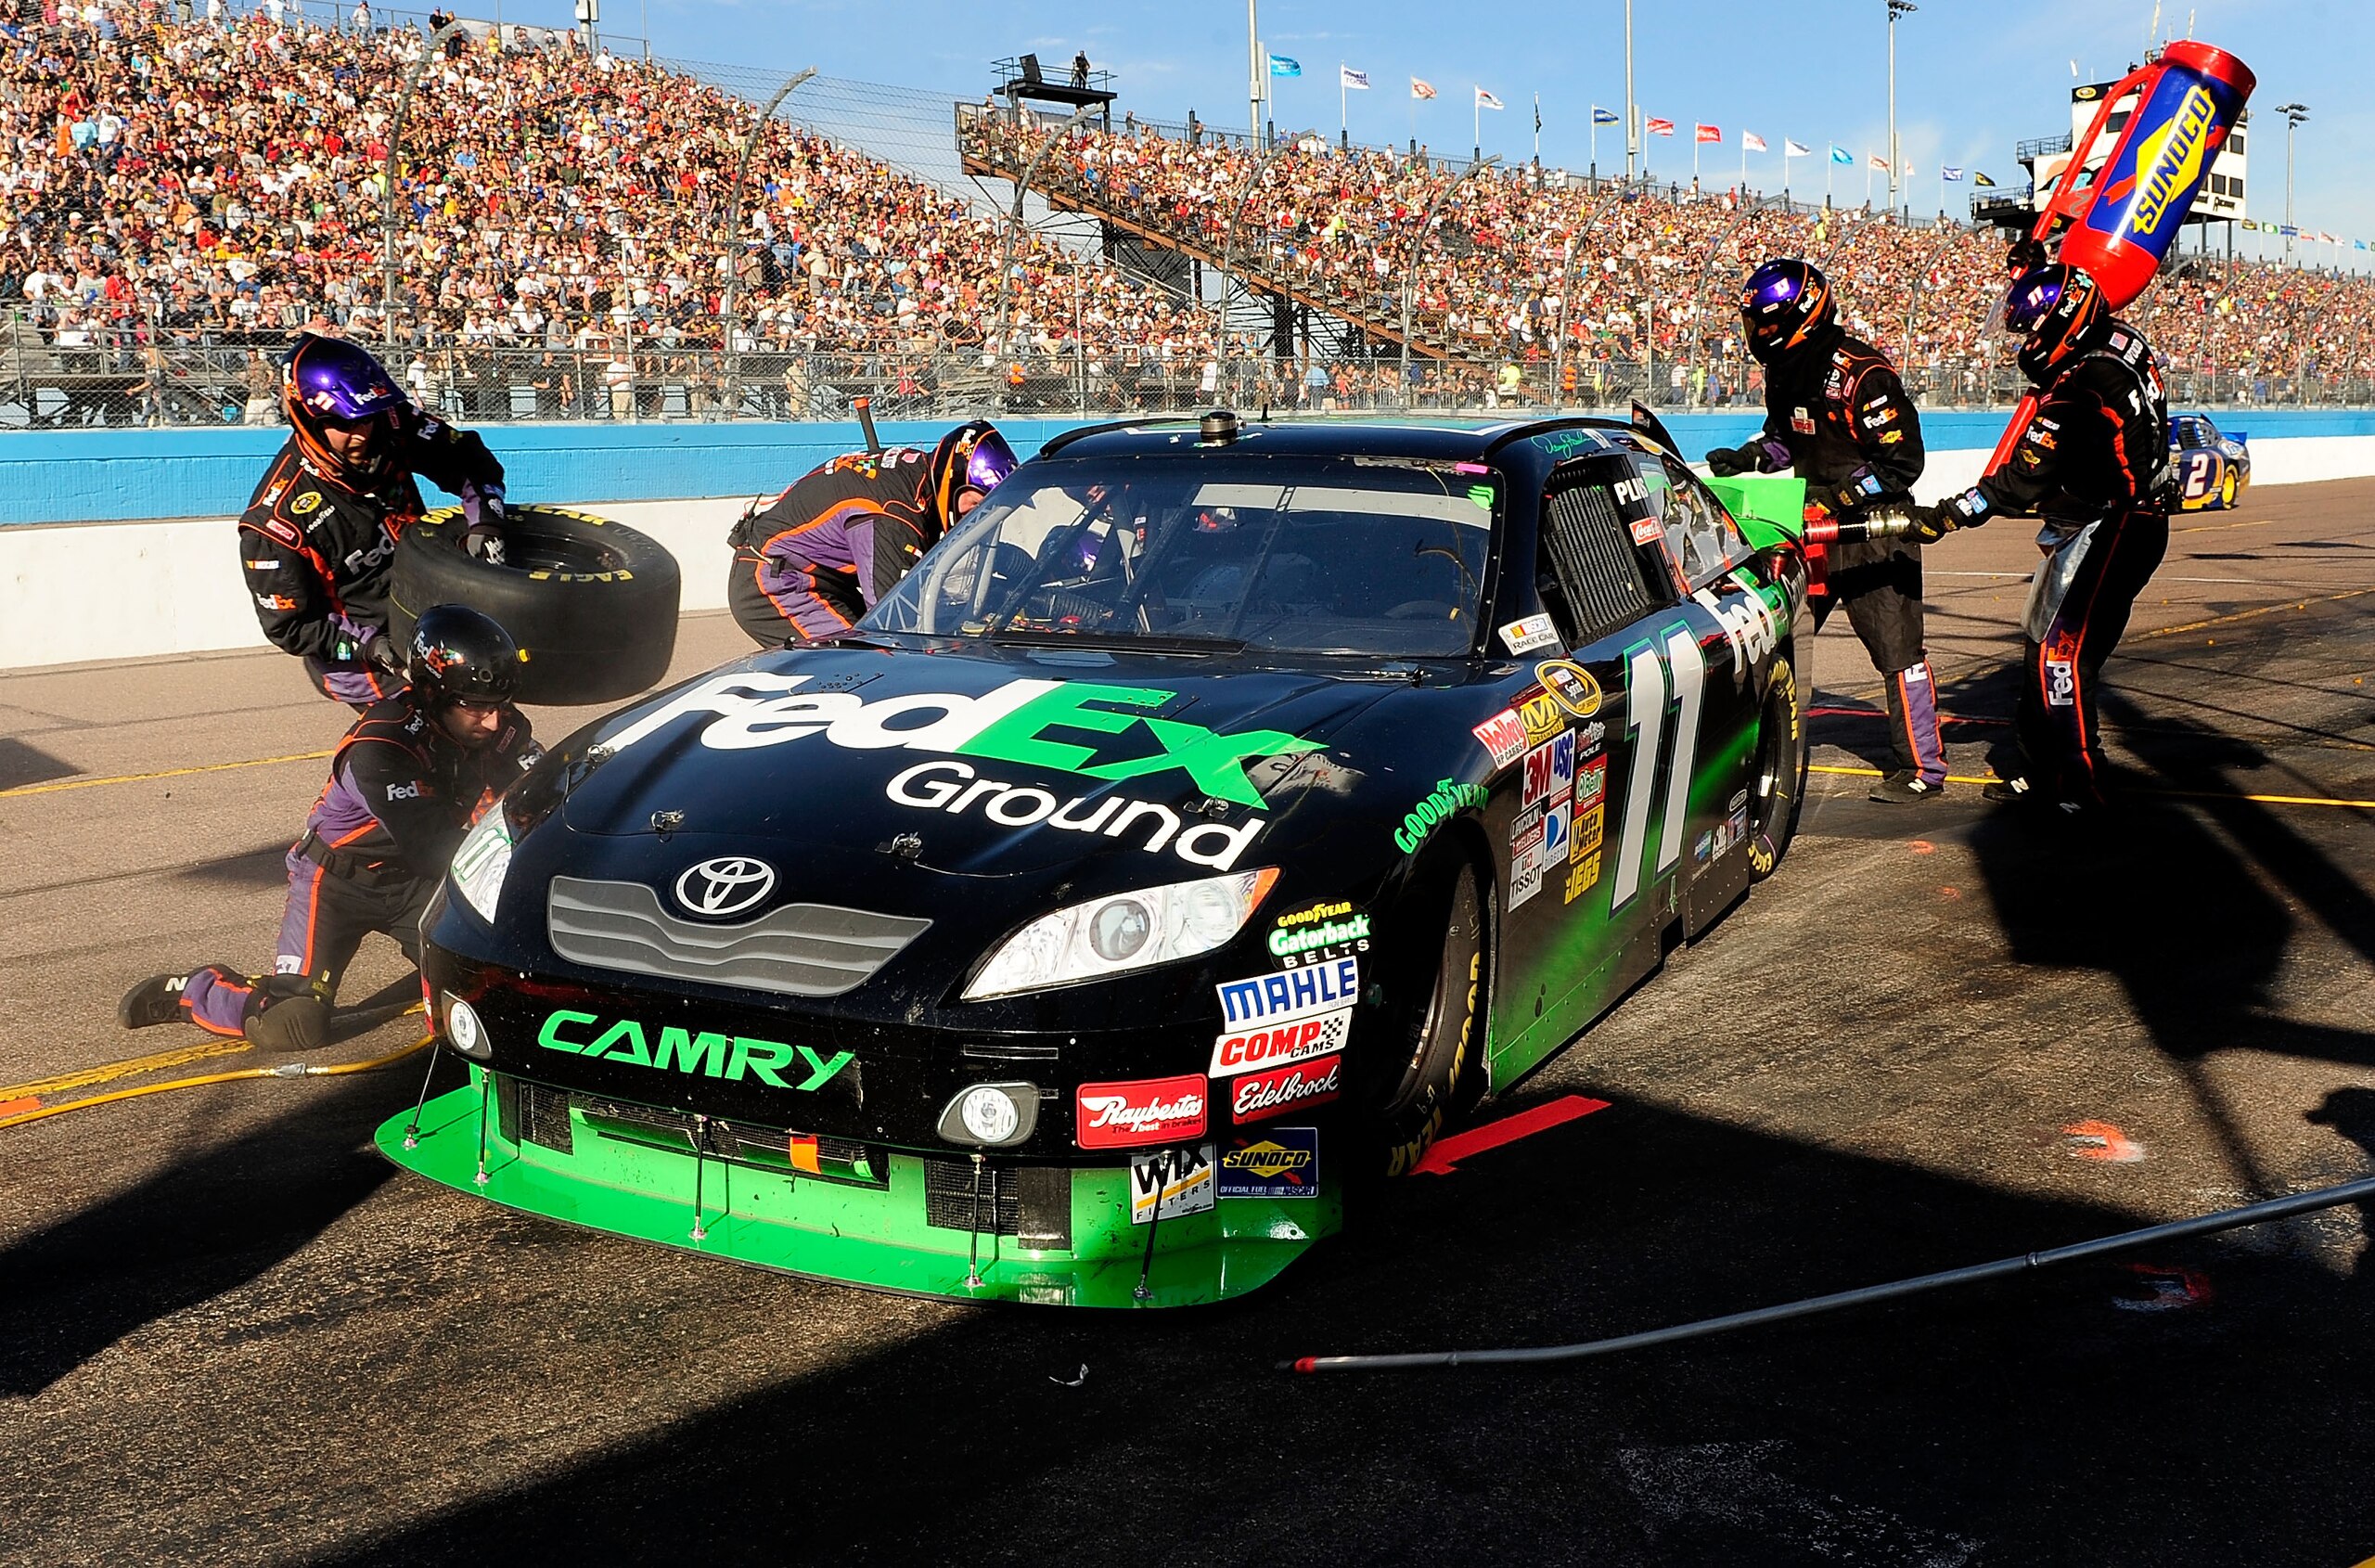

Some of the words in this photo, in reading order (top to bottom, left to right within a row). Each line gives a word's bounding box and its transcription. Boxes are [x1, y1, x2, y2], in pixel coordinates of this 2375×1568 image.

[2135, 91, 2213, 230] SUNOCO
[2059, 288, 2083, 317] FedEx
[1863, 408, 1898, 430] FedEx
[2026, 425, 2057, 449] FedEx
[1614, 477, 1649, 506] PLUS
[2185, 453, 2208, 497] 2
[414, 631, 446, 674] FedEx
[1513, 636, 1538, 649] RACE
[1538, 632, 1557, 643] CAR
[2048, 629, 2078, 706] FedEx
[603, 671, 1330, 810] FedEx
[1476, 717, 1527, 756] Holley
[1579, 742, 1600, 761] POLE
[1524, 745, 1552, 805] 3M
[1554, 732, 1573, 781] USG
[1610, 620, 1704, 919] 11
[386, 780, 437, 802] FedEx
[886, 760, 1266, 872] Ground
[1394, 778, 1489, 855] GOODYEAR
[1511, 806, 1541, 841] LINCOLN
[1513, 825, 1541, 853] WELDERS
[1510, 864, 1542, 899] TISSOT
[1564, 850, 1602, 906] JEGS
[1277, 902, 1352, 928] GOODYEAR
[1269, 914, 1370, 957] Gatorback
[1283, 939, 1370, 970] BELTS
[1221, 959, 1356, 1022] MAHLE
[537, 1009, 855, 1091] CAMRY
[1220, 1021, 1322, 1066] COMP
[1290, 1038, 1335, 1059] CAMS
[1233, 1064, 1340, 1114] Edelbrock
[1080, 1094, 1203, 1133] Raybestos
[1112, 1125, 1131, 1134] The
[1138, 1122, 1160, 1132] best
[1135, 1143, 1209, 1195] WIX
[1226, 1150, 1309, 1168] SUNOCO
[1220, 1186, 1250, 1194] OFFICIAL
[1252, 1186, 1267, 1194] FUEL
